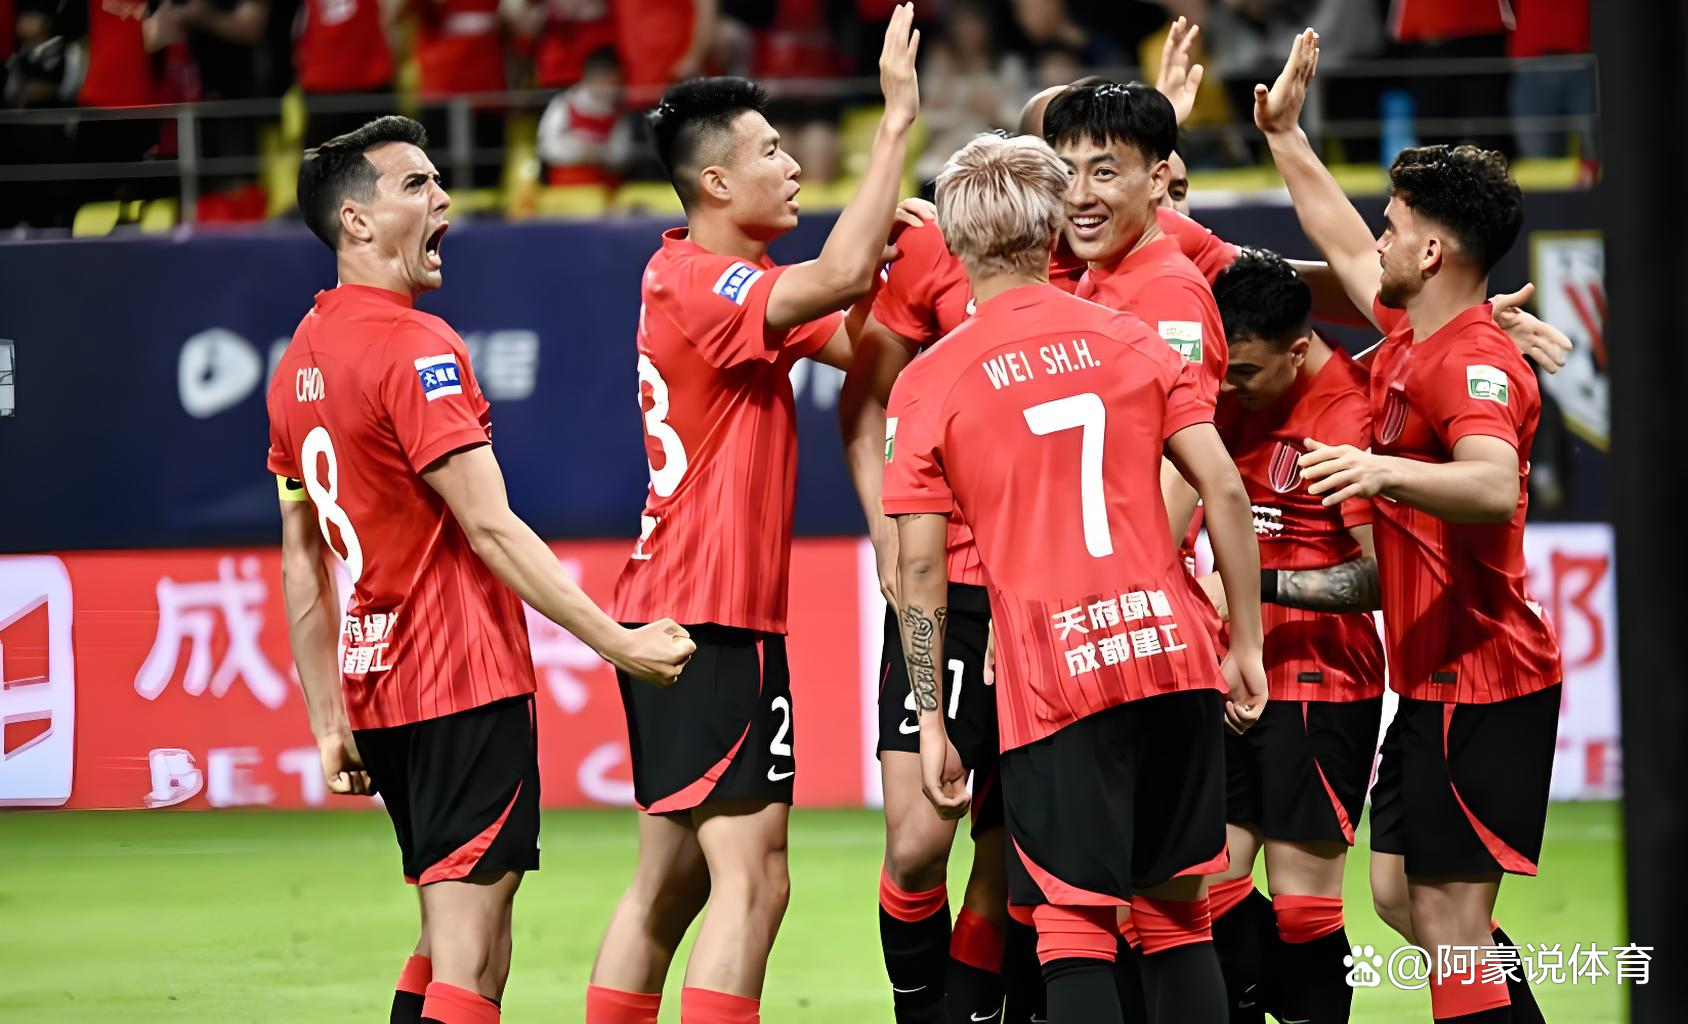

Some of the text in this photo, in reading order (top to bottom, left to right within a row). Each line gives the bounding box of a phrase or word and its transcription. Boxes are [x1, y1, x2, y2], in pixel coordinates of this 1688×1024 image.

[982, 338, 1101, 390] WEI SH.H.
[301, 427, 364, 584] 8
[1023, 392, 1113, 558] 7
[769, 695, 792, 757] 2
